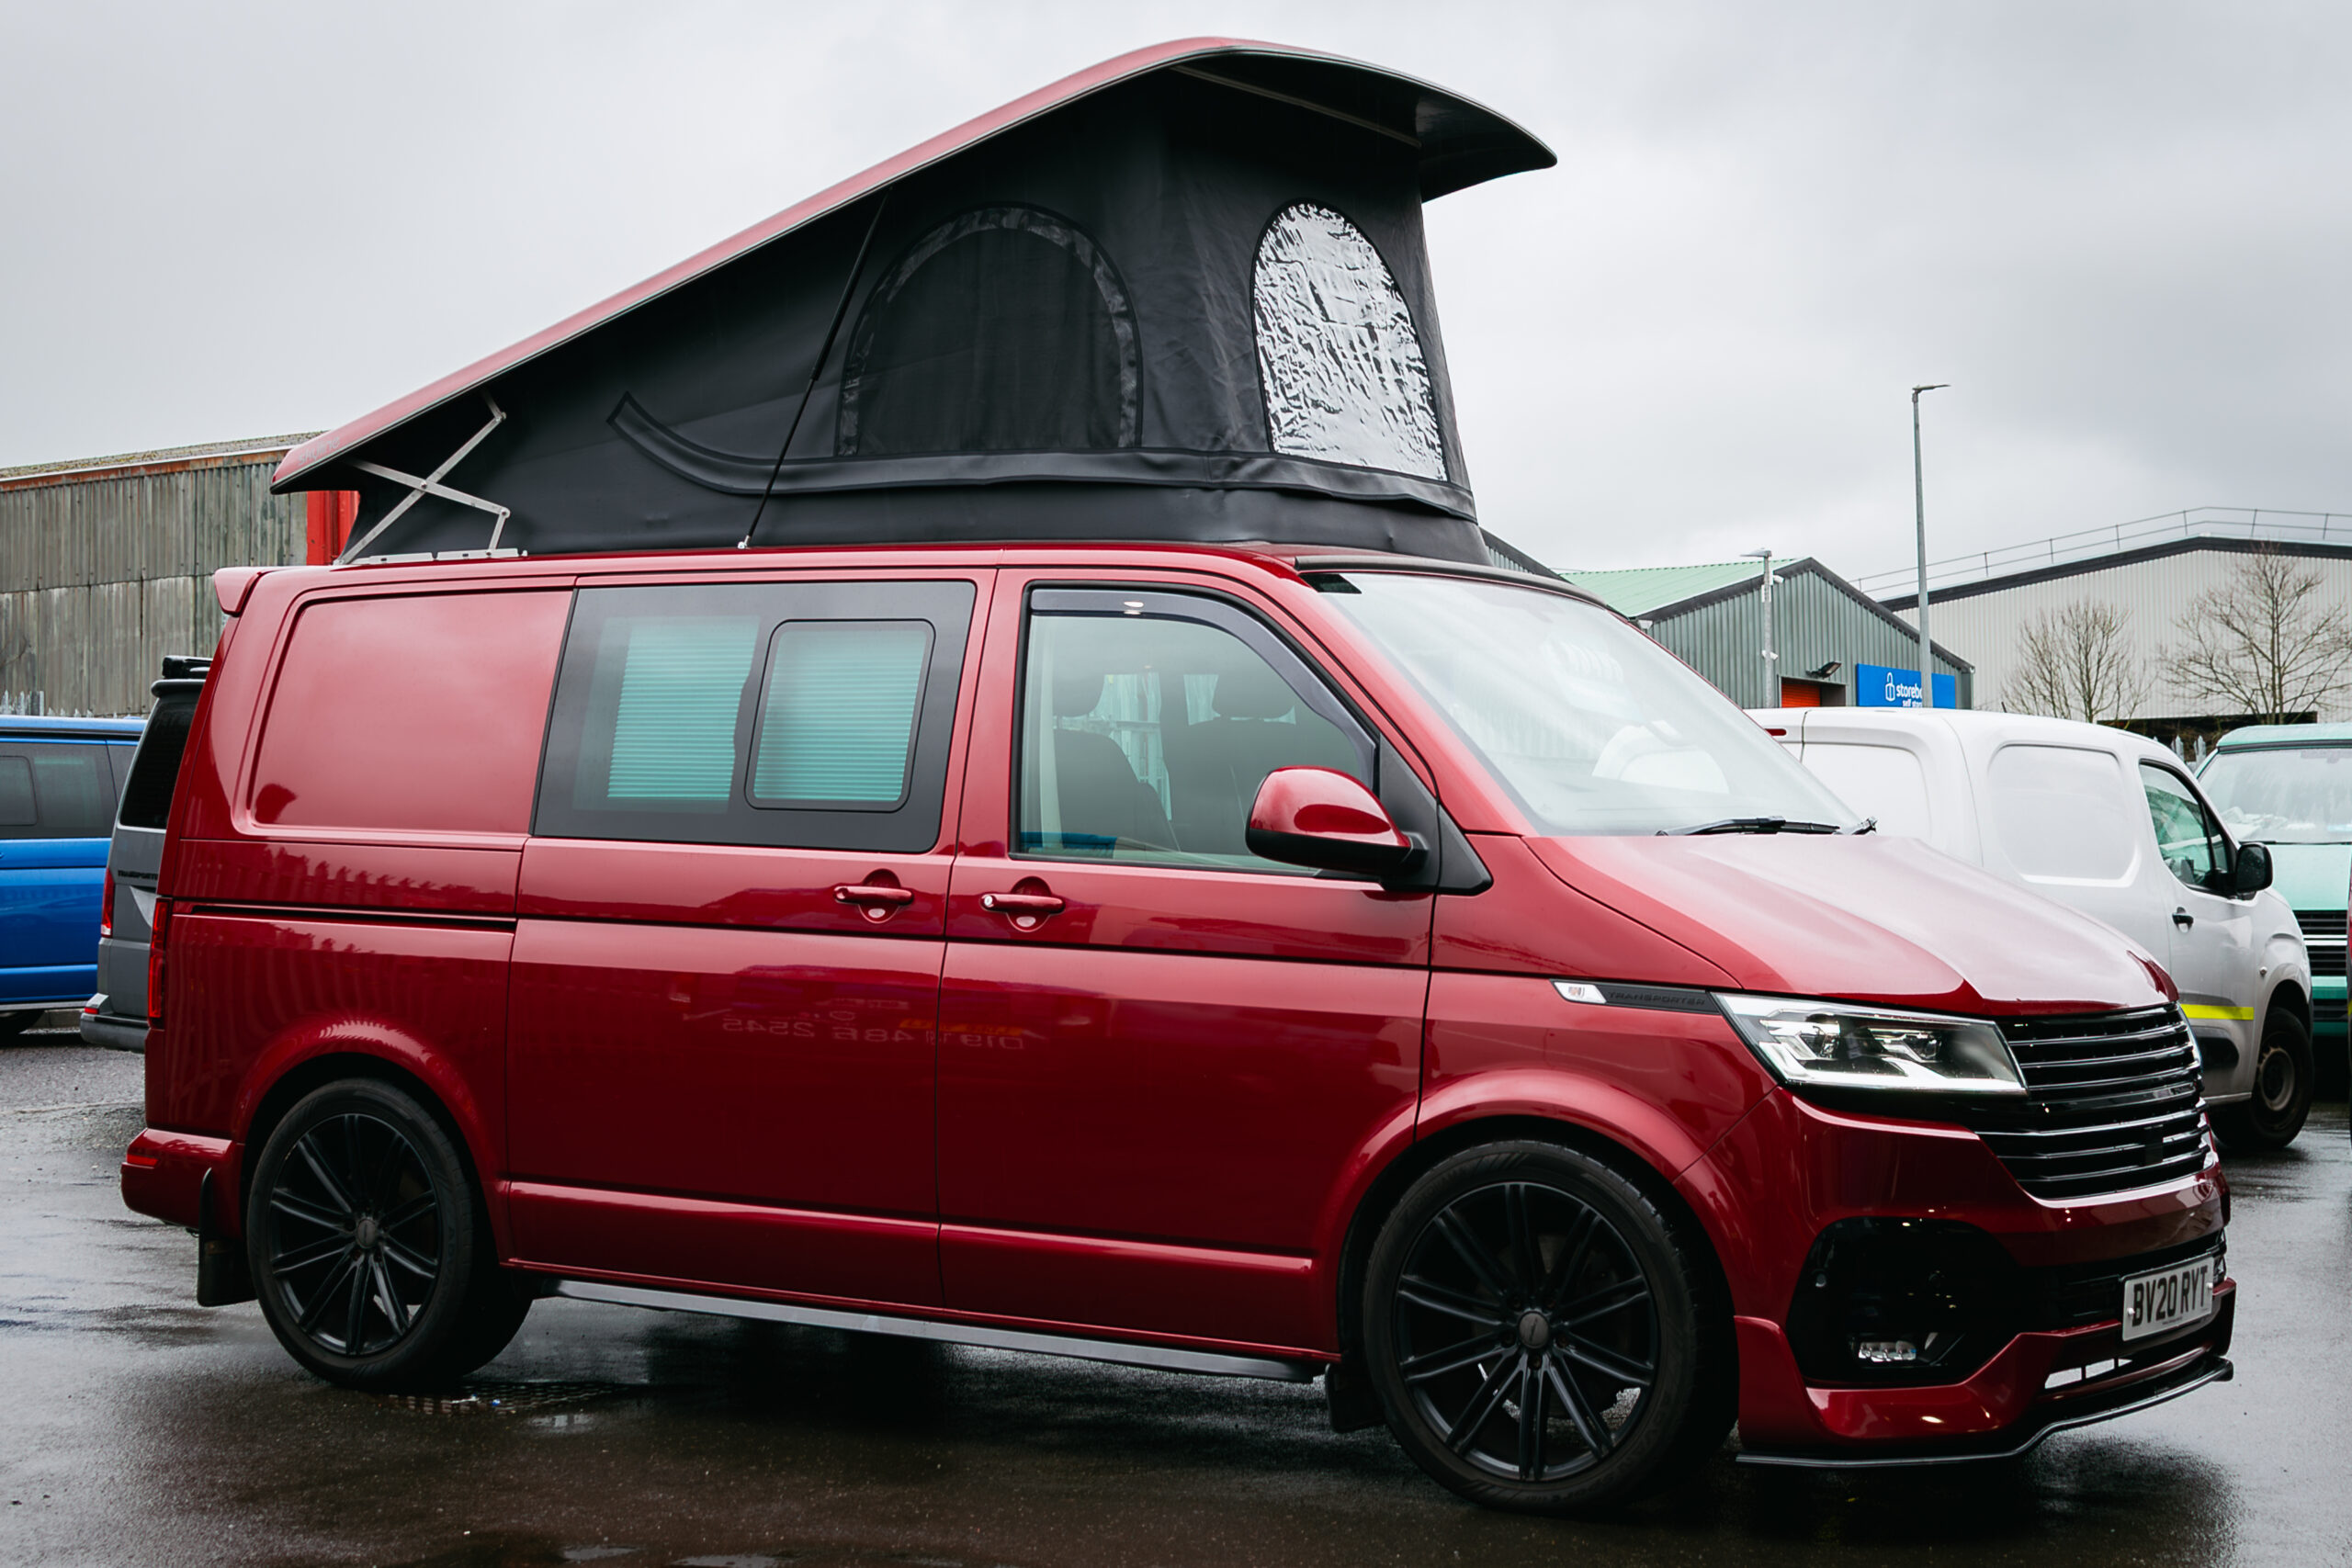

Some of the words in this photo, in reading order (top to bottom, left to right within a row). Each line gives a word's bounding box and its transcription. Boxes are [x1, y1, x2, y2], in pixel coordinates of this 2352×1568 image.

[1609, 992, 1706, 1006] TRANSPORTER
[2132, 1275, 2177, 1326] BV20
[2180, 1265, 2208, 1314] RYT
